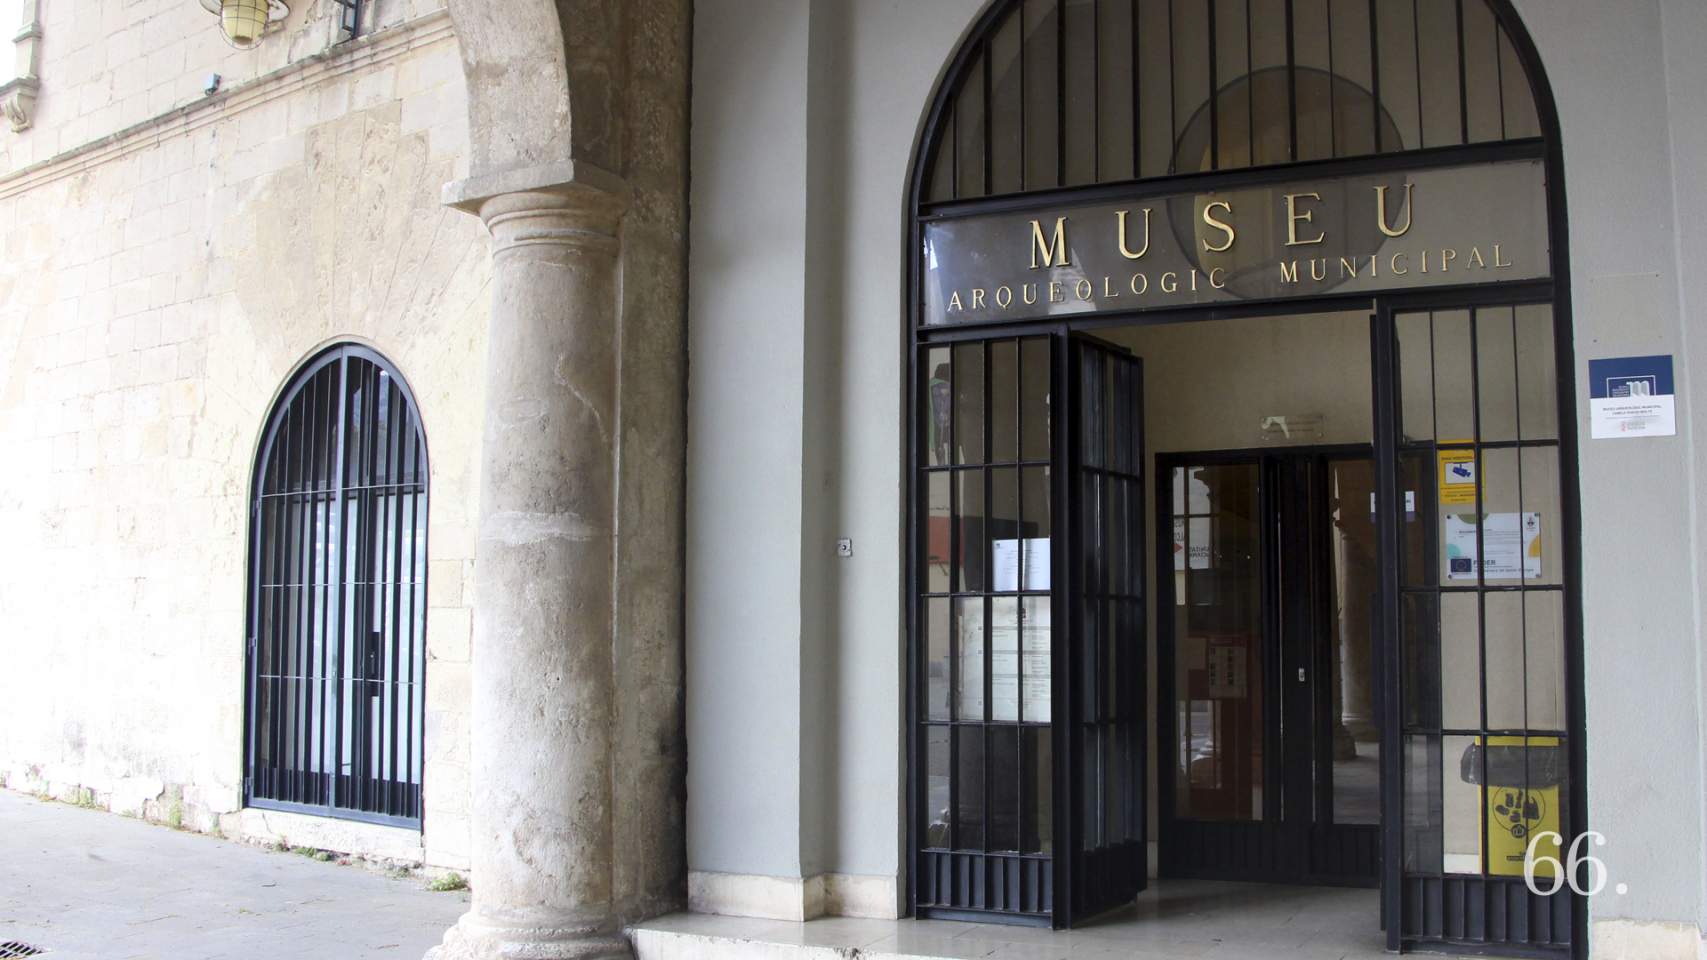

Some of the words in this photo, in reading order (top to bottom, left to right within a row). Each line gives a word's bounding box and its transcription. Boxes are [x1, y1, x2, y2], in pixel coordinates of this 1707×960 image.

[1029, 183, 1415, 270] MUSEU
[947, 267, 1226, 312] ARQUEOLOGIC
[1279, 244, 1513, 284] MUNICIPAL
